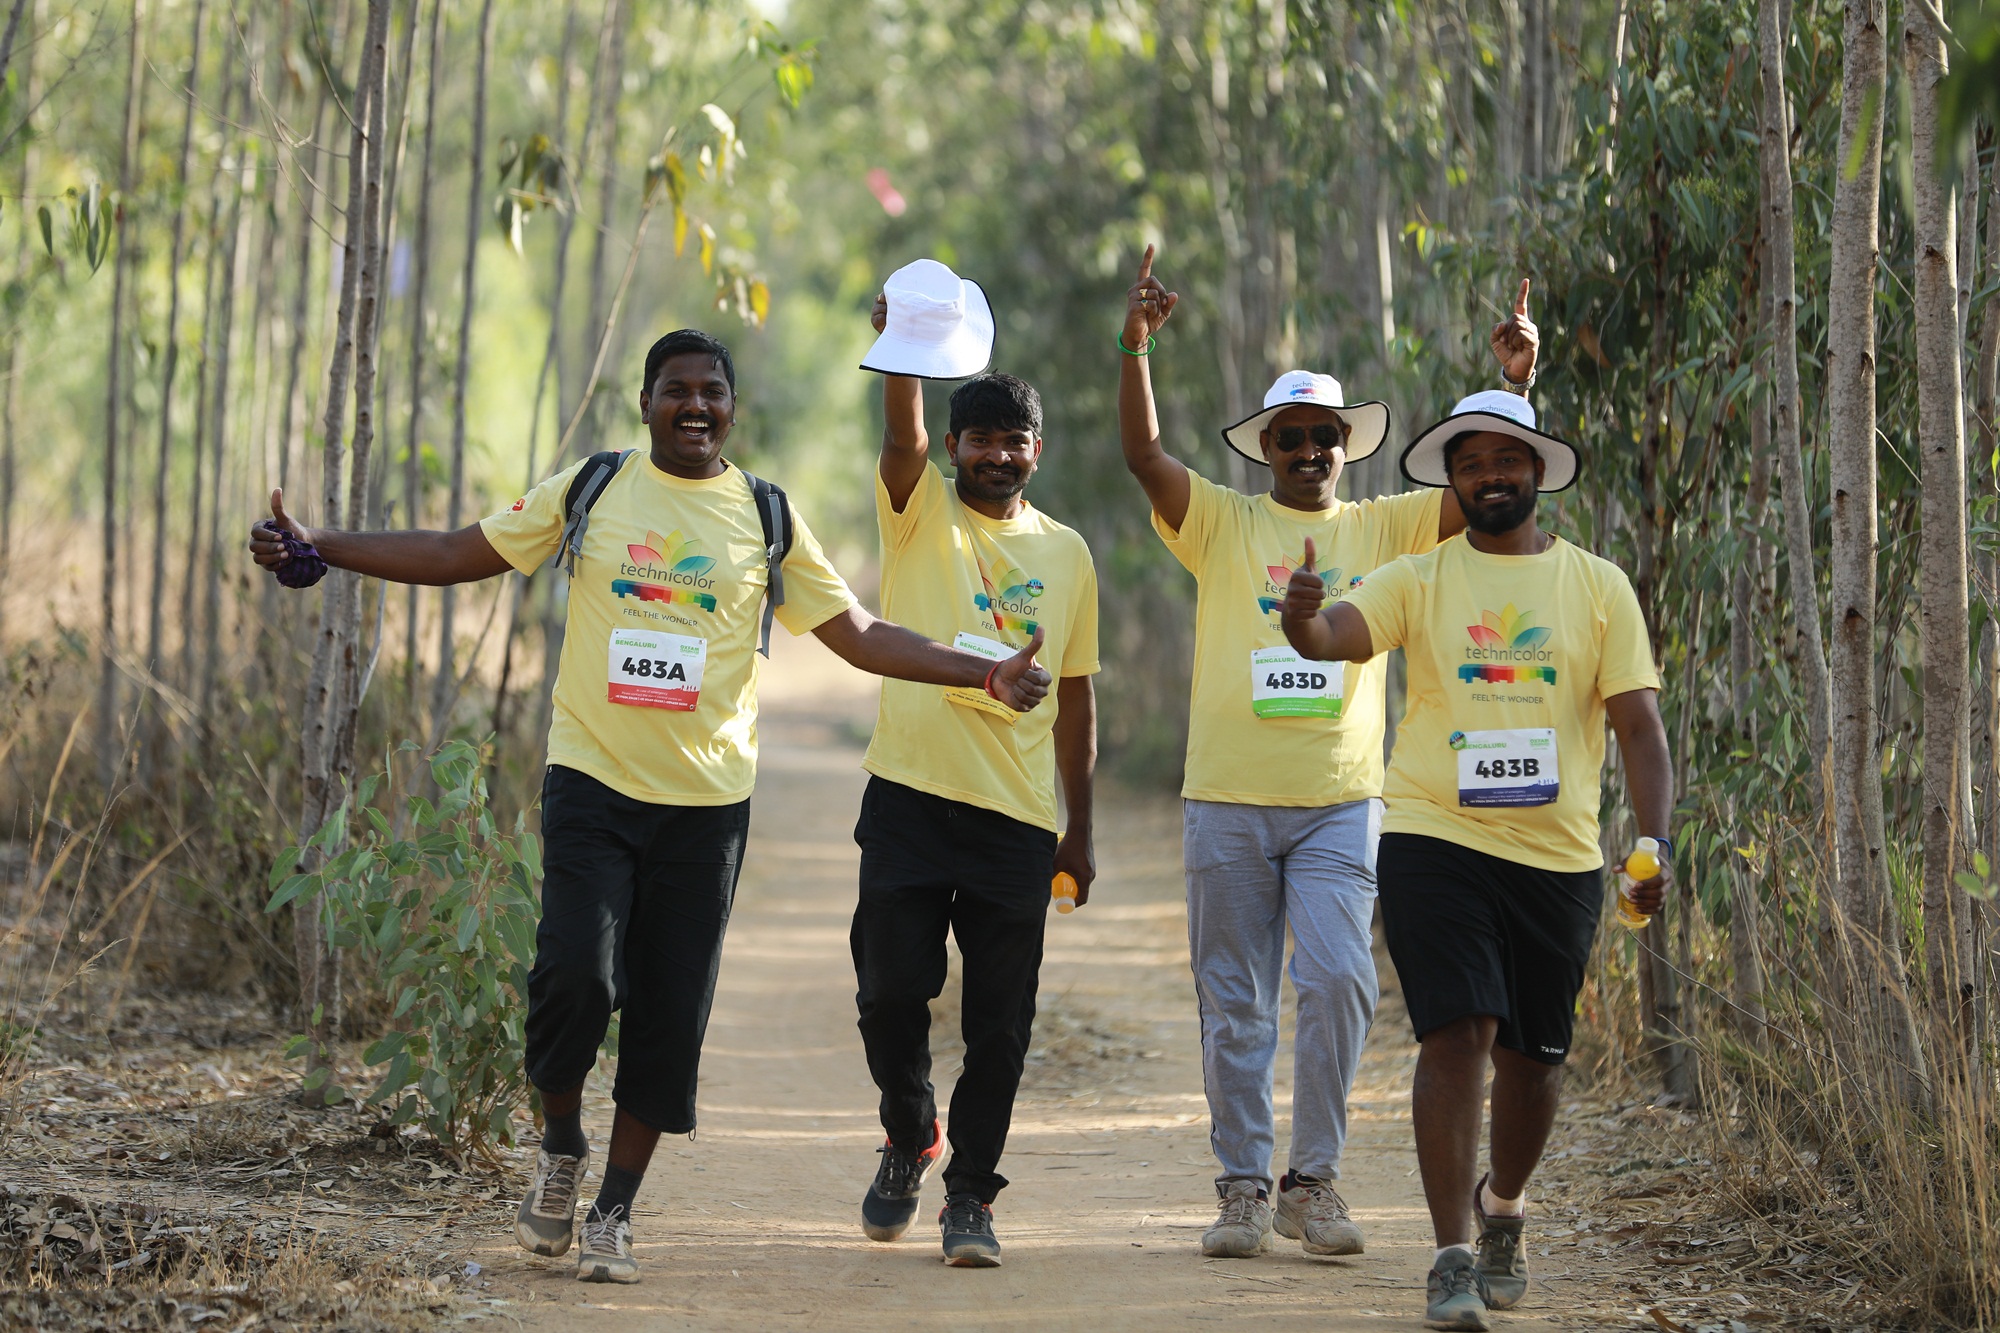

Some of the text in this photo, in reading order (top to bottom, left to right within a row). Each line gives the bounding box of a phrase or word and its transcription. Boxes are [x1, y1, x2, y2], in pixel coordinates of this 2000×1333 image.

[620, 562, 716, 590] technicolor
[989, 595, 1039, 617] nicolor
[623, 608, 698, 627] FEEL THE WONDER
[981, 620, 997, 633] FEEL
[615, 639, 657, 649] BENGALURU
[959, 641, 998, 658] BENGALURU
[1465, 643, 1553, 662] technicolor
[622, 656, 686, 682] 483A
[1266, 672, 1327, 690] 483D
[1472, 693, 1544, 704] FEEL THE WONDER
[1475, 758, 1540, 779] 483B
